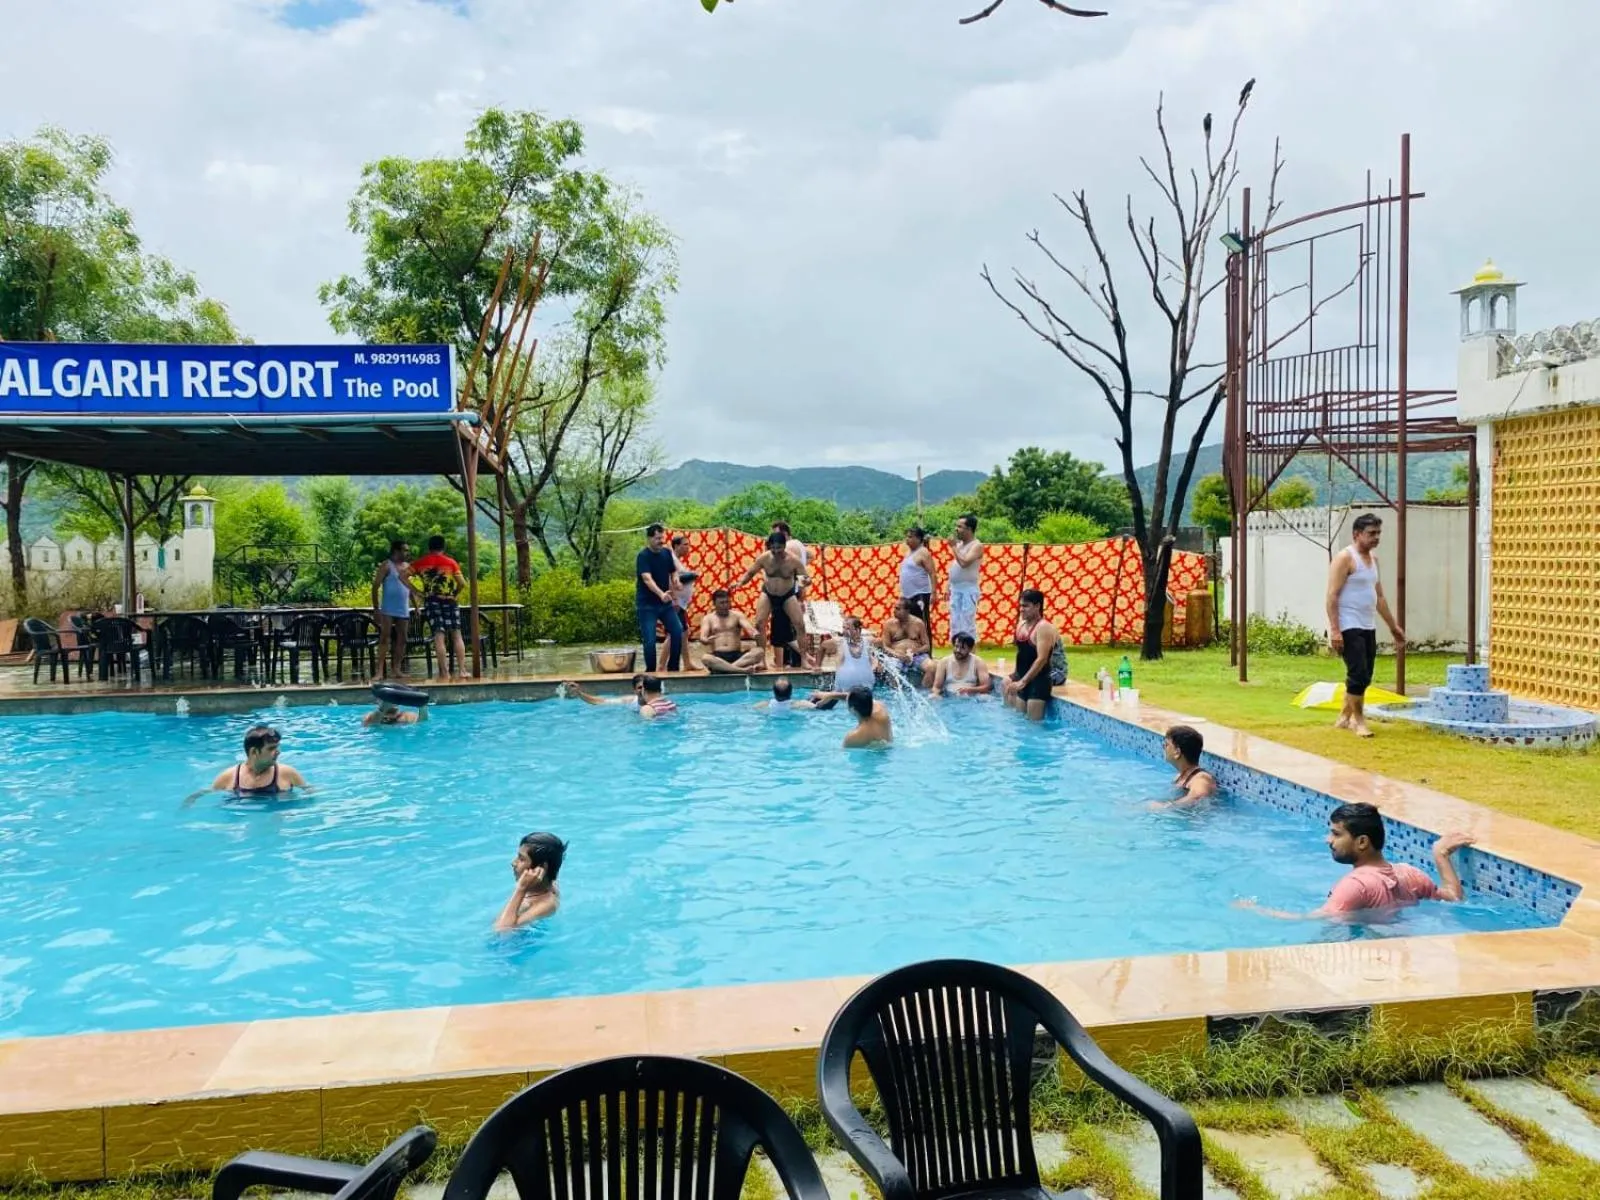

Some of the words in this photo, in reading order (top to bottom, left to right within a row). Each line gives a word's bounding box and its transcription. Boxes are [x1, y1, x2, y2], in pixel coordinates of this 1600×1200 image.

[354, 353, 368, 364] M.
[370, 353, 441, 365] 9829114983
[0, 358, 169, 398] ALGARH
[181, 360, 339, 399] RESORT
[343, 377, 383, 398] The
[392, 377, 440, 398] Pool
